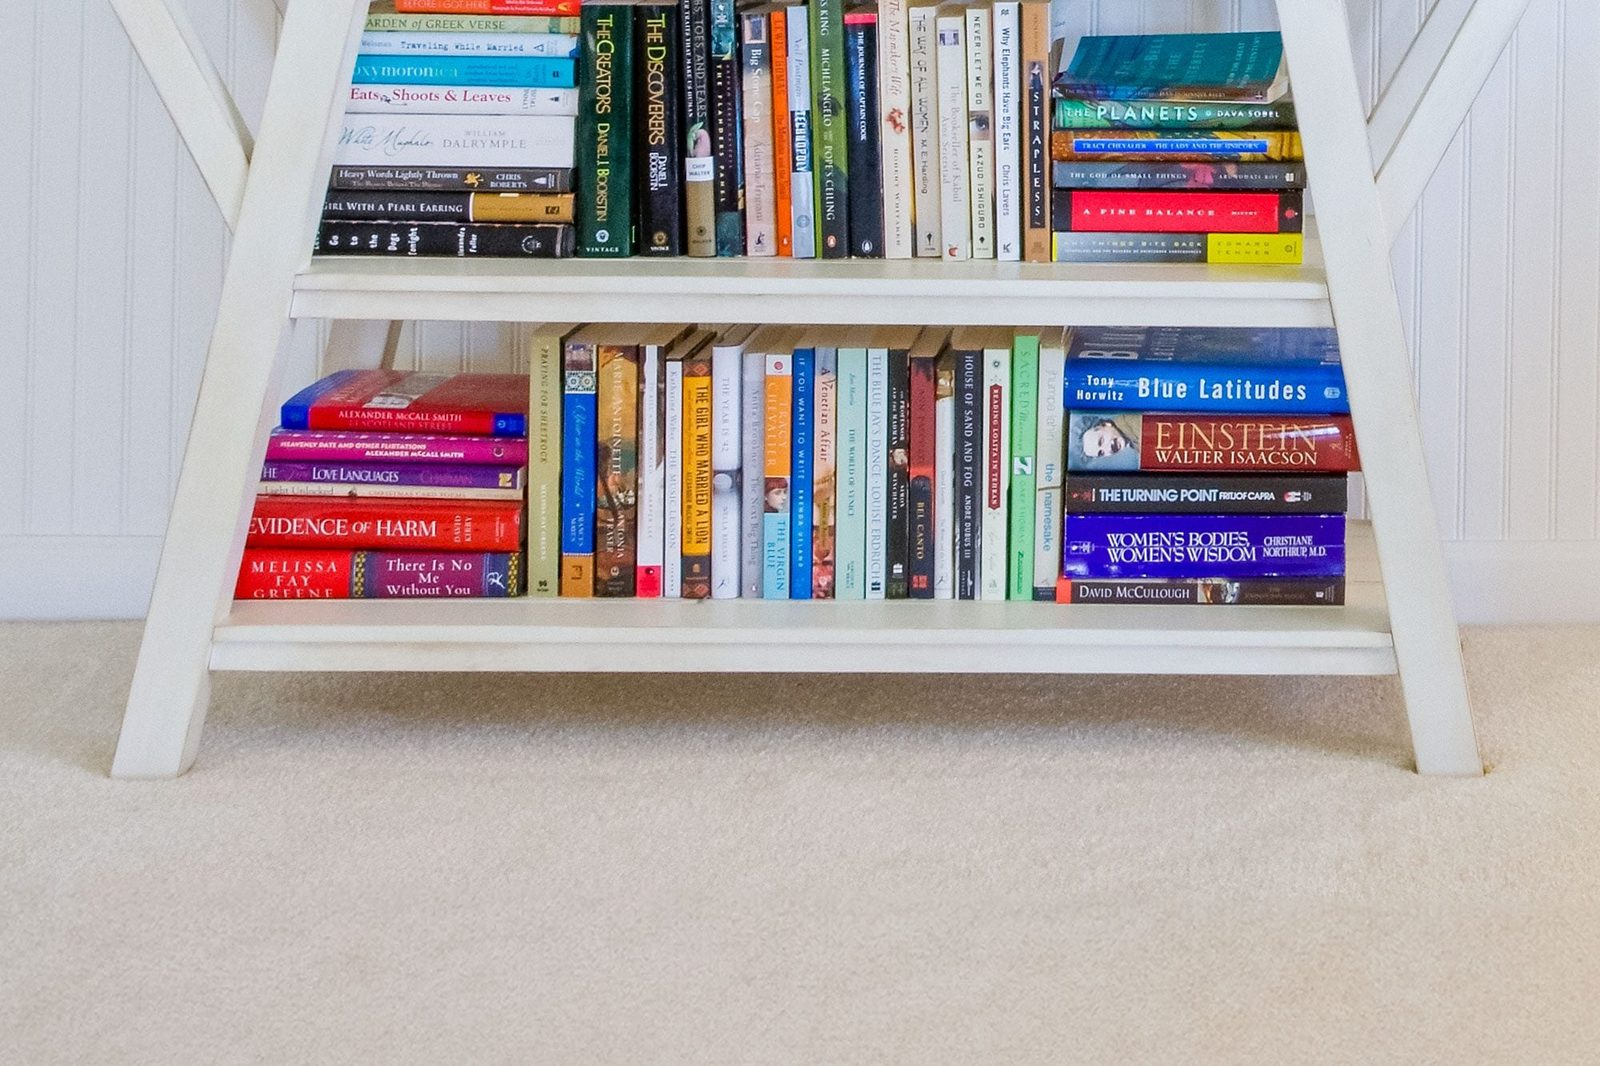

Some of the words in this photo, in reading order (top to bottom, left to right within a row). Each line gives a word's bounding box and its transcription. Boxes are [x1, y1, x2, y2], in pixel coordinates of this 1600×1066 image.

[412, 19, 422, 30] of
[426, 19, 464, 29] GREEK
[470, 20, 505, 30] VERSE
[647, 14, 666, 43] THE
[974, 16, 982, 48] NEVER
[857, 31, 865, 46] THE
[999, 28, 1010, 46] Why
[696, 55, 705, 79] AND
[857, 46, 866, 76] JOURNALS
[1000, 48, 1011, 89] Elephants
[596, 40, 614, 114] CREATORS
[859, 77, 866, 90] OF
[975, 76, 982, 87] ME
[392, 90, 440, 101] Shoots
[445, 91, 457, 101] &
[463, 91, 511, 103] Leaves
[647, 47, 666, 145] DISCOVERERS
[697, 84, 706, 118] TEARS
[859, 92, 867, 120] CAPTAIN
[975, 92, 983, 105] GO
[1002, 92, 1011, 113] Have
[1000, 116, 1011, 129] Big
[1065, 108, 1091, 117] THE
[1096, 106, 1198, 121] PLANETS
[1217, 110, 1244, 118] DAVA
[717, 95, 725, 157] FLANDERS
[859, 121, 867, 141] COOK
[443, 139, 527, 149] DALRYMPLE
[793, 111, 806, 172] TECHNOPOLY
[1002, 133, 1011, 150] Ears
[1032, 91, 1042, 217] STRAPLESS
[340, 170, 364, 179] Heavy
[368, 171, 393, 179] Words
[395, 171, 423, 180] Lightly
[426, 171, 458, 179] Thrown
[649, 152, 659, 190] BOORSTIN
[1002, 164, 1011, 186] Chris
[1002, 189, 1011, 216] Lavers
[329, 235, 339, 246] Go
[349, 235, 358, 246] to
[369, 235, 378, 249] the
[872, 355, 881, 376] THE
[964, 355, 973, 388] HOUSE
[1087, 375, 1114, 389] Tony
[1138, 378, 1188, 398] Blue
[1199, 379, 1307, 400] Latitudes
[696, 385, 708, 403] THE
[872, 381, 881, 406] BLUE
[964, 393, 973, 406] OF
[1077, 390, 1123, 401] Horwitz
[991, 388, 999, 425] READING
[696, 407, 708, 430] GIRL
[767, 382, 777, 468] CHEVALIER
[779, 402, 788, 449] TRACY
[870, 411, 881, 434] JAY'S
[964, 410, 973, 437] SAND
[696, 433, 708, 456] WHO
[798, 432, 805, 444] TO
[848, 429, 856, 444] THE
[1156, 423, 1321, 451] EINSTEIN
[669, 449, 678, 470] THE
[848, 446, 856, 475] WORLD
[871, 440, 881, 476] DANCE
[964, 440, 972, 462] AND
[1156, 450, 1224, 464] WALTER
[1231, 451, 1317, 465] ISAACSON
[797, 449, 805, 479] WRITE
[991, 460, 998, 470] IN
[1045, 464, 1055, 482] the
[696, 460, 708, 506] MARRIED
[848, 477, 855, 488] OF
[963, 466, 972, 487] FOG
[669, 473, 677, 507] MUSIC
[1100, 489, 1124, 502] THE
[1122, 489, 1178, 502] TURNING
[1181, 489, 1218, 502] POINT
[871, 486, 880, 525] LOUISE
[916, 502, 925, 519] BEL
[248, 518, 348, 536] EVIDENCE
[376, 520, 437, 537] HARM
[464, 516, 472, 542] KIRBY
[669, 510, 677, 549] LESSON
[1042, 492, 1052, 551] namesake
[606, 518, 614, 553] FRASER
[616, 510, 625, 558] ANTONIA
[695, 521, 708, 544] LION
[776, 521, 785, 545] THE
[916, 524, 924, 559] CANTO
[1107, 532, 1185, 546] WOMEN'S
[1189, 532, 1251, 547] BODIES,
[1264, 536, 1313, 546] CHRISTIANE
[767, 542, 776, 570] BLUE
[871, 529, 880, 579] ERDRICH
[1107, 547, 1185, 563] WOMEN'S
[1188, 547, 1256, 562] WISDOM
[1263, 547, 1309, 557] NORTHRUP,
[1310, 547, 1327, 557] M.D.
[252, 561, 337, 573] MELISSA
[387, 560, 425, 572] There
[432, 561, 445, 572] Is
[451, 561, 472, 571] No
[776, 549, 785, 591] VIRGIN
[276, 575, 310, 587] FAY
[419, 573, 439, 584] Me
[387, 584, 440, 595] Without
[445, 584, 471, 595] You
[1080, 586, 1112, 598] DAVID
